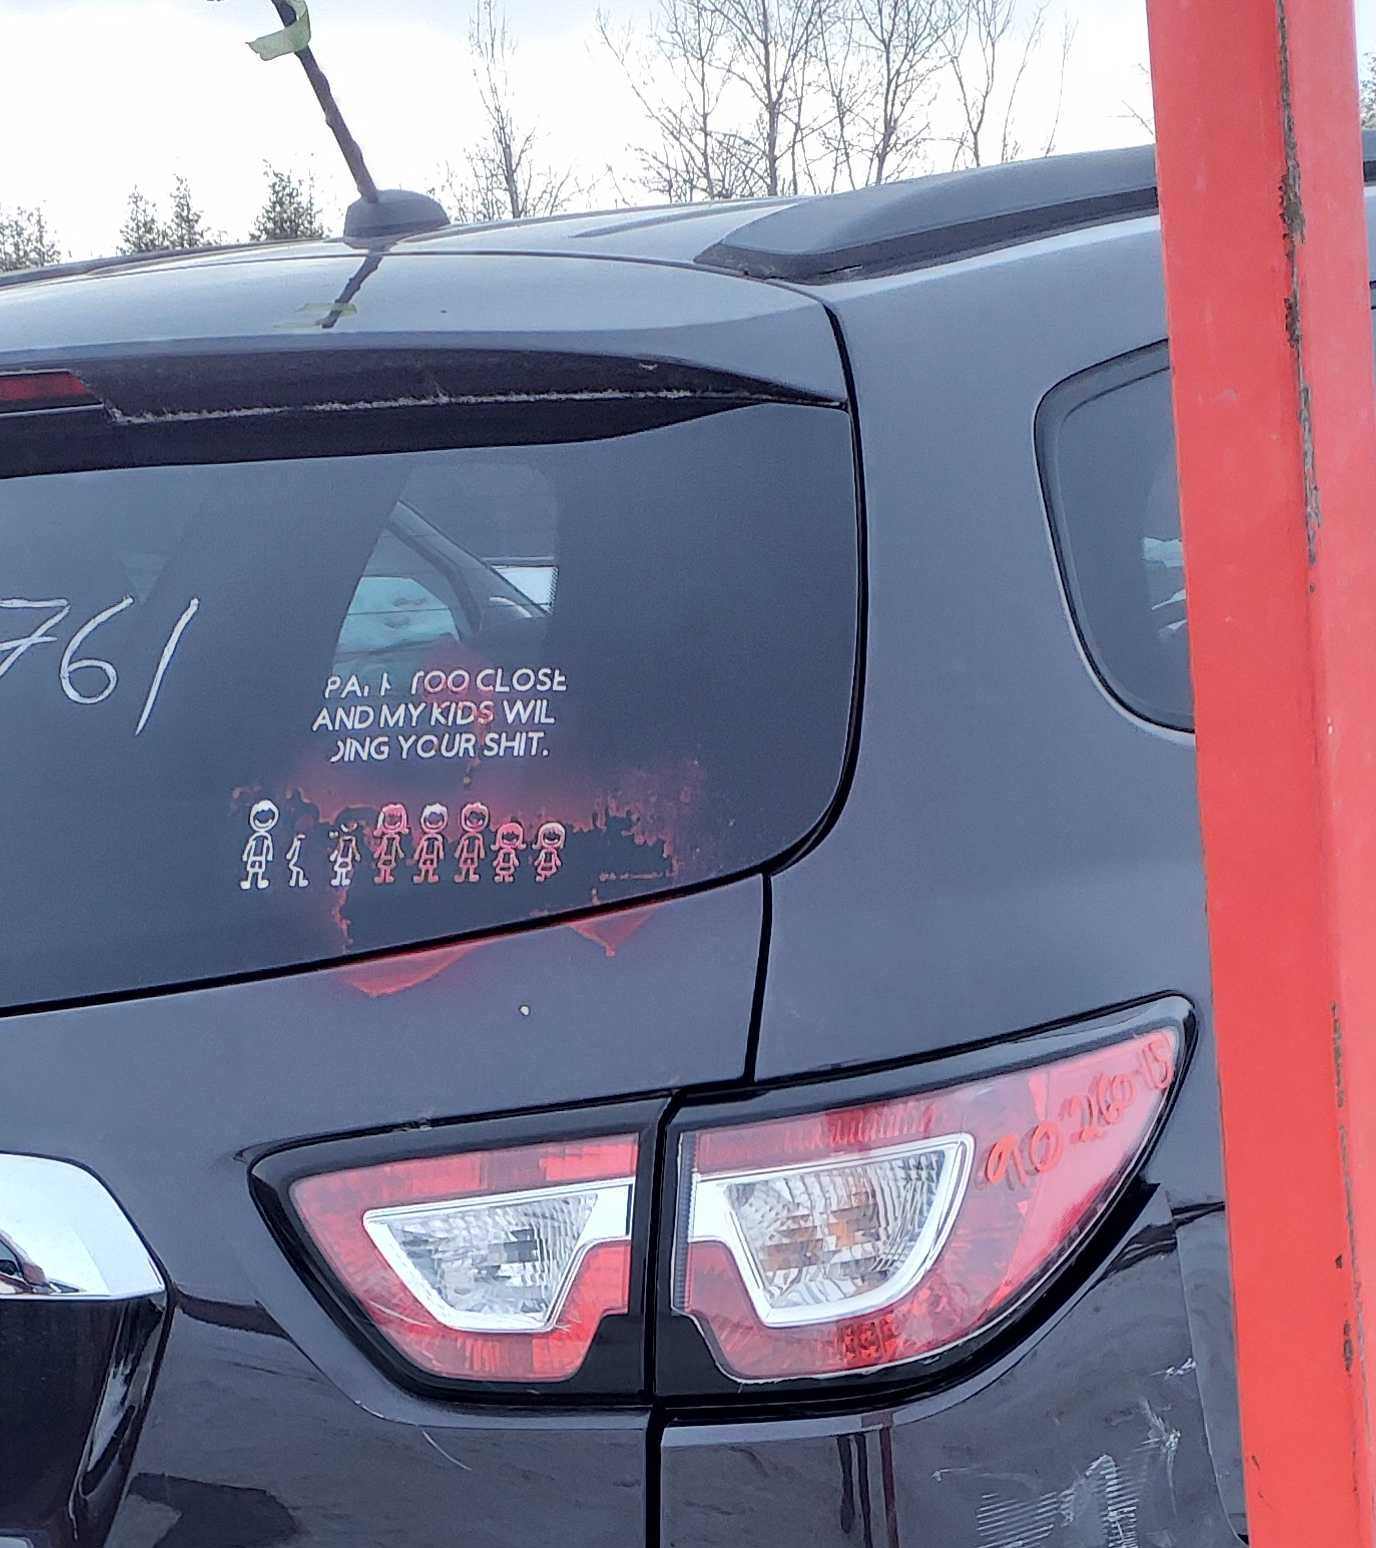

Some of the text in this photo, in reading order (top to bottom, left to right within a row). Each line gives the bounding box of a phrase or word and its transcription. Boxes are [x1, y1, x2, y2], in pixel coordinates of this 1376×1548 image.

[476, 668, 567, 693] CLOSE
[311, 705, 374, 731] AND
[379, 702, 426, 727] MY
[430, 700, 494, 725] KIDS
[398, 734, 476, 759] YOUR
[483, 732, 549, 757] SHIT.
